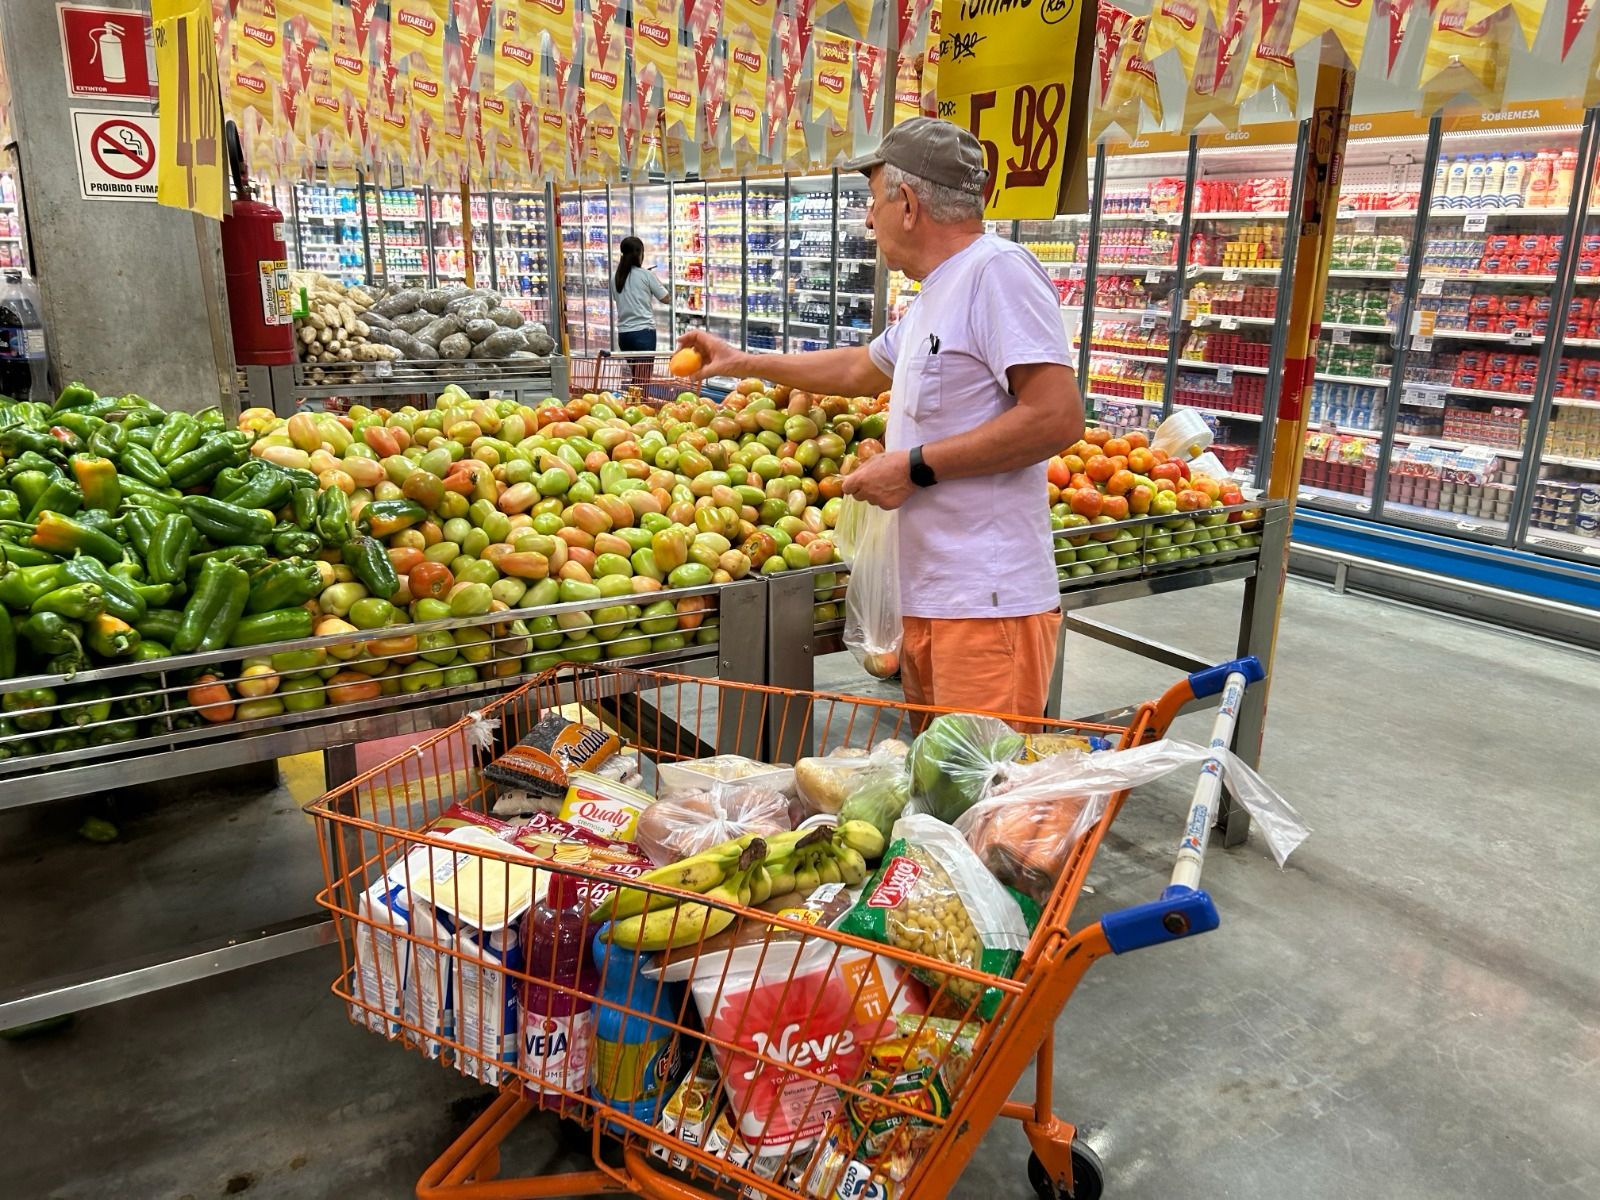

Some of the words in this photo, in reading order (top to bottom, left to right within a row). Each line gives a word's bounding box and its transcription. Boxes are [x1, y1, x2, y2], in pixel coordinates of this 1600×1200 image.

[400, 12, 434, 32] VITARELLA
[244, 25, 273, 43] VITARELLA
[640, 24, 669, 42] VITARELLA
[503, 45, 532, 61] VITARELLA
[334, 55, 361, 71] VITARELLA
[1480, 109, 1540, 122] SOBREMESA
[1348, 122, 1373, 132] REGO
[1225, 131, 1250, 141] GREGO
[90, 182, 133, 193] PROIBIDO
[135, 185, 159, 193] FUMA
[579, 802, 630, 827] Qualy
[863, 1000, 882, 1017] 11
[525, 1032, 569, 1058] VEJA
[743, 1023, 855, 1080] Neve
